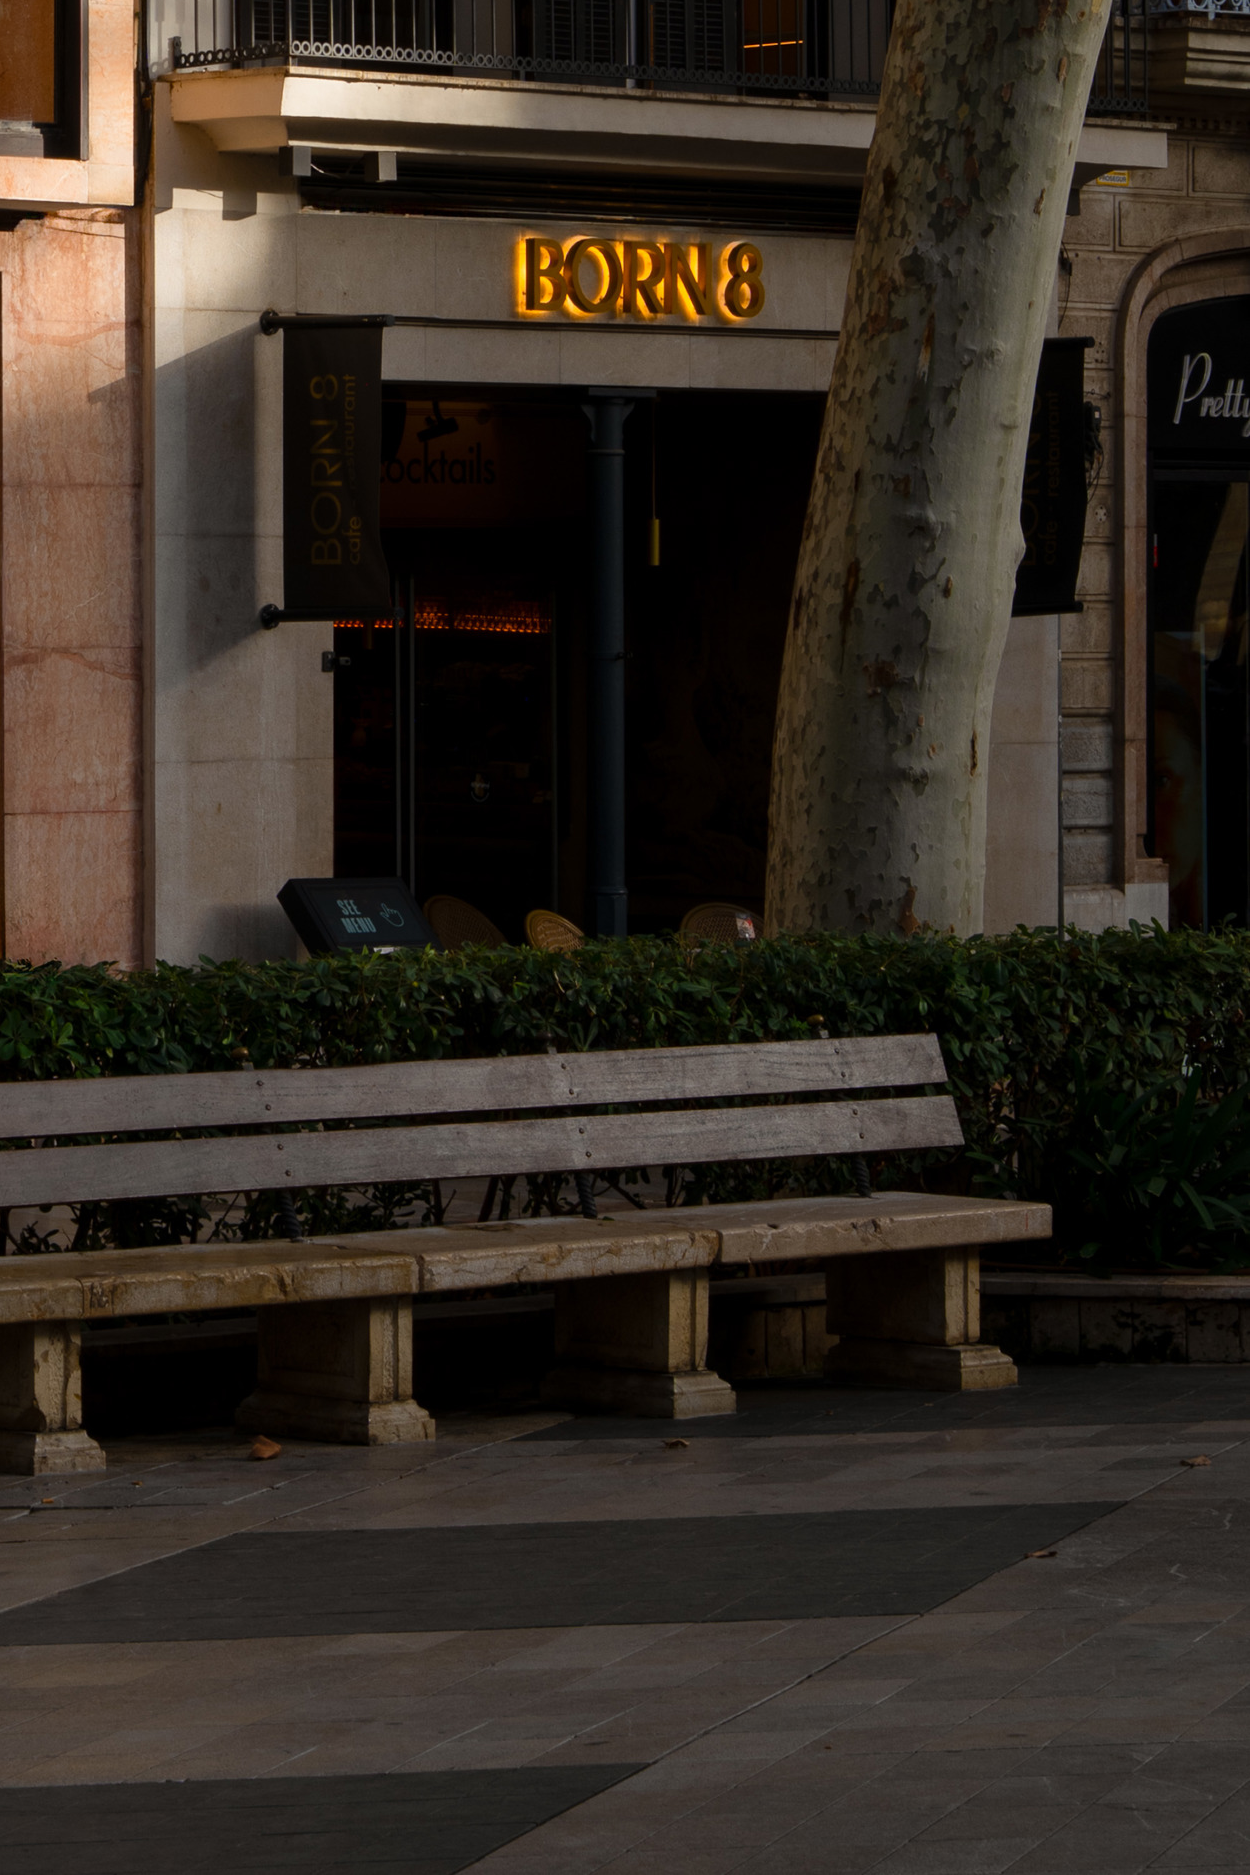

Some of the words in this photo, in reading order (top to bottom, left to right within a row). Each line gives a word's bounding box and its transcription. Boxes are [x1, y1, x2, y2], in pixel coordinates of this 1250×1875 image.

[524, 237, 713, 316] BORN
[724, 242, 766, 318] 8
[309, 373, 340, 401] 8
[309, 418, 343, 565] BORN
[336, 899, 362, 915] SEE
[340, 917, 377, 933] MENU
